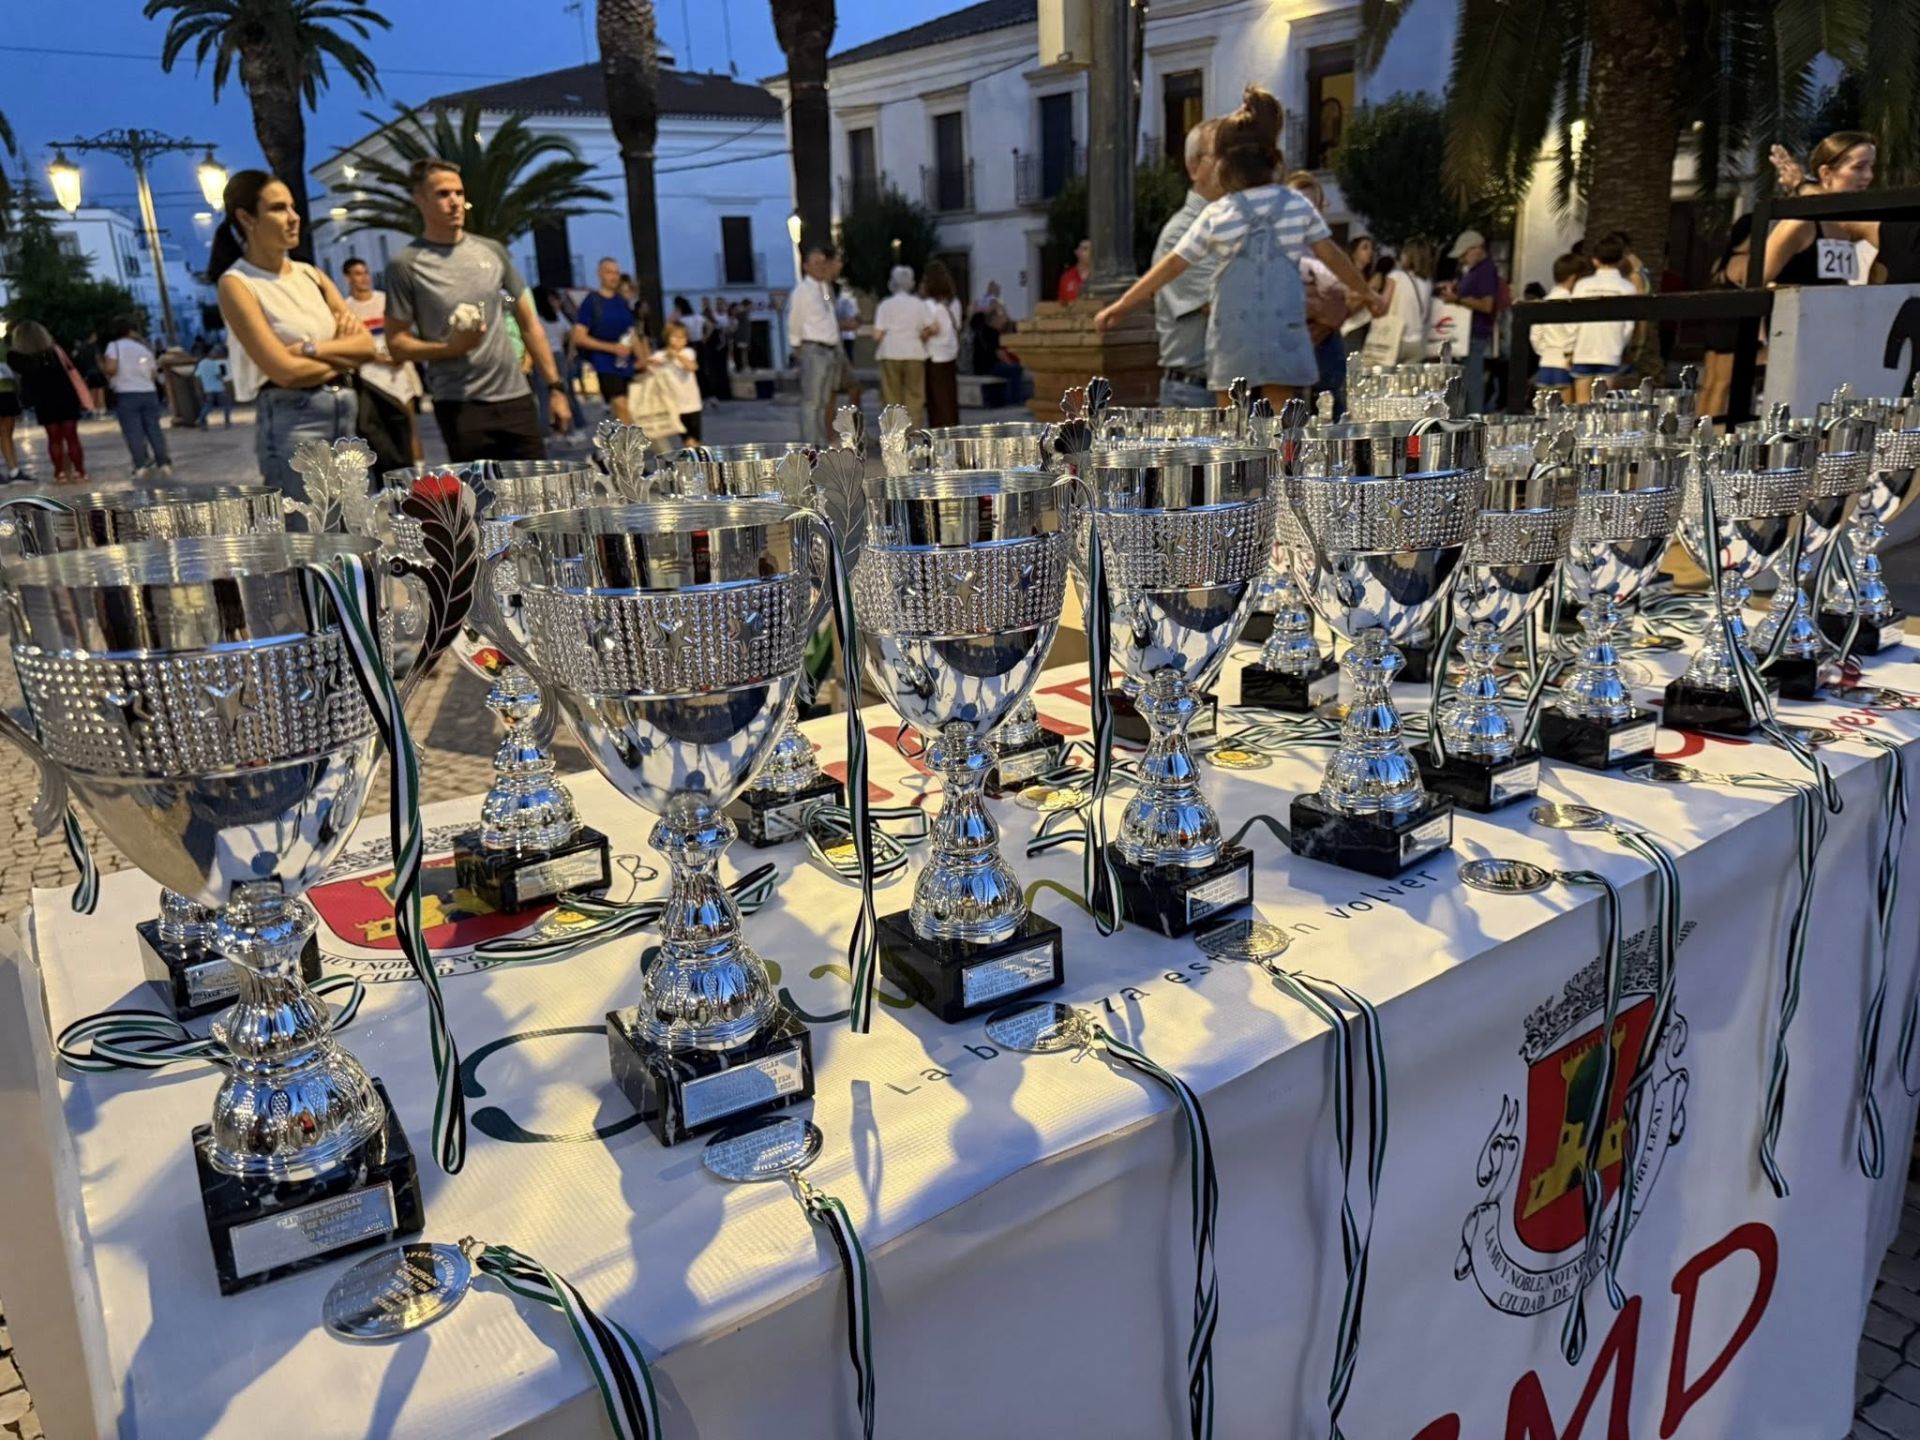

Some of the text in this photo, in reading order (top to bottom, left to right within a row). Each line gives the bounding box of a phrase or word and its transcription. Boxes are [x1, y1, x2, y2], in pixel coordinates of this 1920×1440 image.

[1824, 249, 1853, 275] 211
[885, 1067, 953, 1096] La
[1324, 869, 1439, 921] volver
[1646, 1101, 1665, 1152] LEAL
[1499, 1283, 1571, 1312] CIUDAD DE
